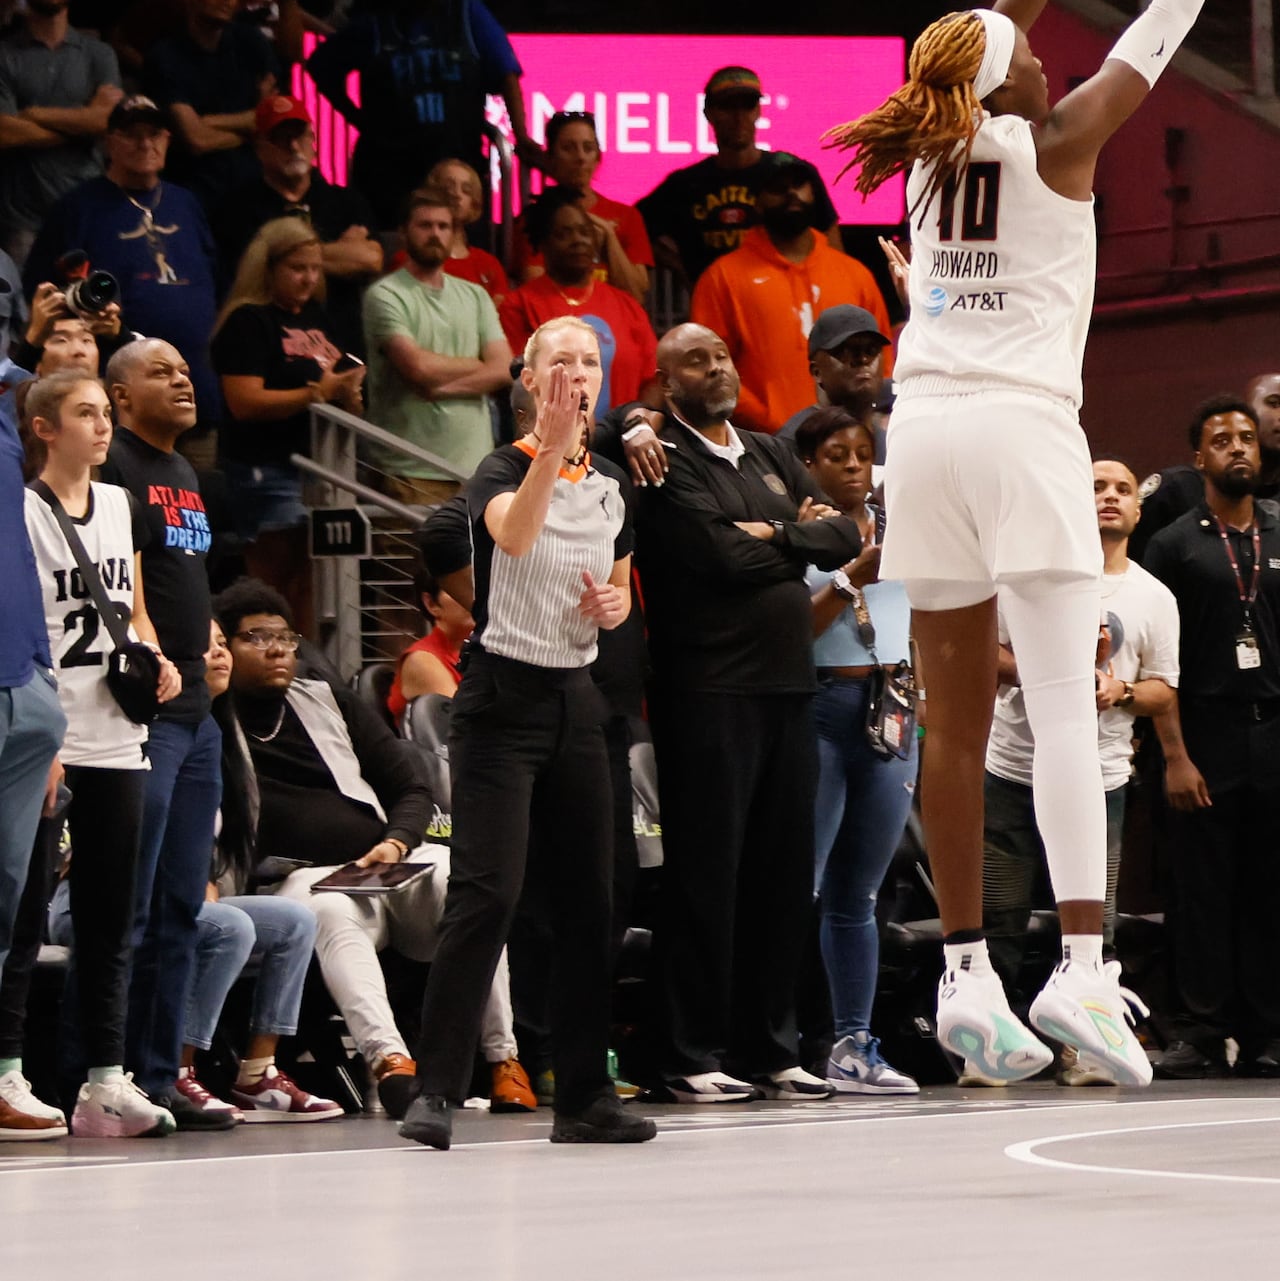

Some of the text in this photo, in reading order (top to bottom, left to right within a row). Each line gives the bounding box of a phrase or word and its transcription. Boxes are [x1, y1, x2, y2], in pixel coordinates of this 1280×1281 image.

[938, 161, 1001, 241] 10
[929, 250, 998, 279] HOWARD
[950, 291, 1009, 311] AT&T
[162, 505, 211, 533] IS THE
[164, 526, 213, 553] DREAM
